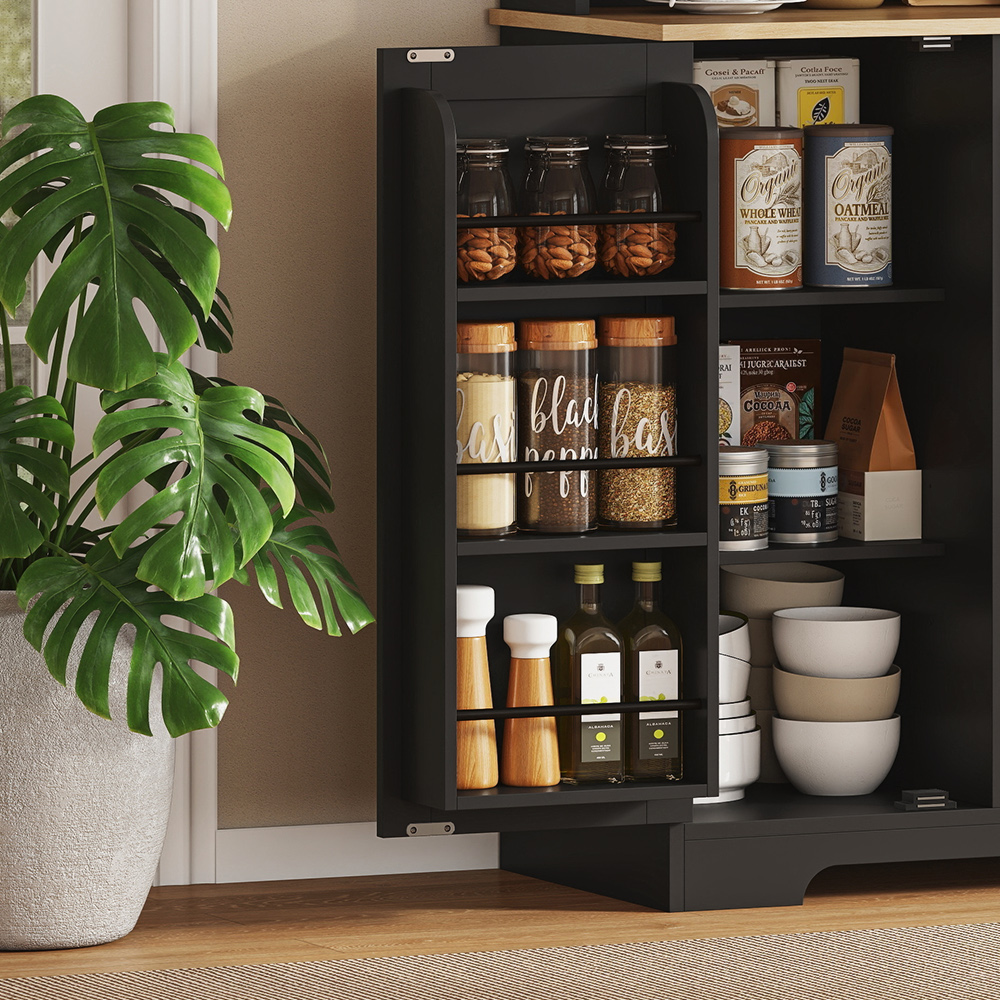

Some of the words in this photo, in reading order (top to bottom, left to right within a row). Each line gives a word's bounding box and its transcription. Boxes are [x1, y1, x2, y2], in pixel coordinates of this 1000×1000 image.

[740, 208, 776, 218] WHOLE
[835, 203, 889, 216] OATMEAL
[842, 417, 861, 426] COCOA
[841, 424, 861, 432] SUGAR
